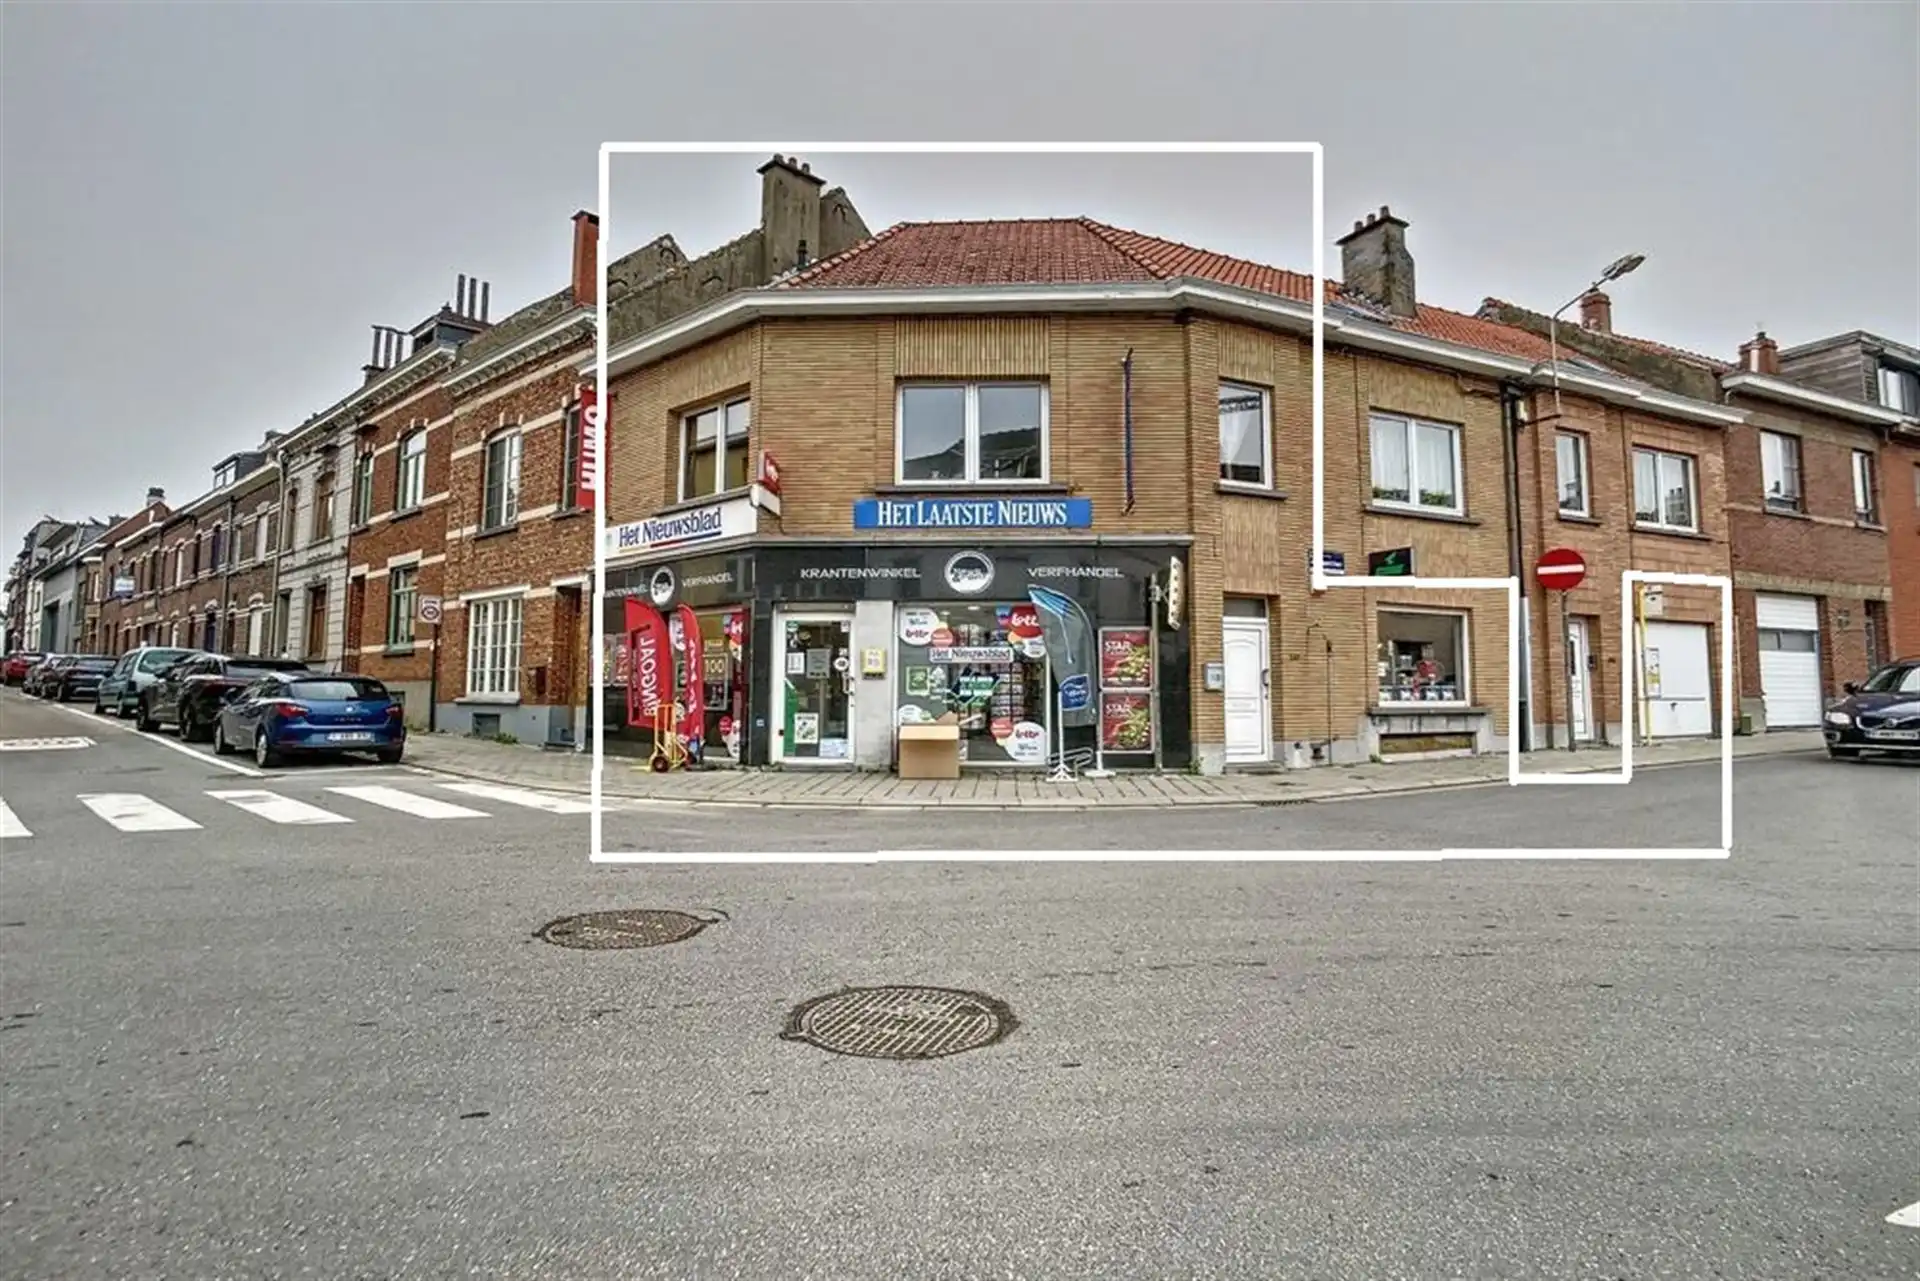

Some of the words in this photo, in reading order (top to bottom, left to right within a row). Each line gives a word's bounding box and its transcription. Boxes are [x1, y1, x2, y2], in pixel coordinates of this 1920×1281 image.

[877, 500, 915, 526] HET
[917, 500, 995, 526] LAATSTE
[997, 500, 1067, 526] NIEUWS
[619, 525, 640, 547] Het
[642, 507, 722, 543] Nieuwsblad
[800, 567, 921, 580] KRANTENWINKEL
[1027, 566, 1125, 579] VERFHANDEL
[705, 659, 724, 673] 100
